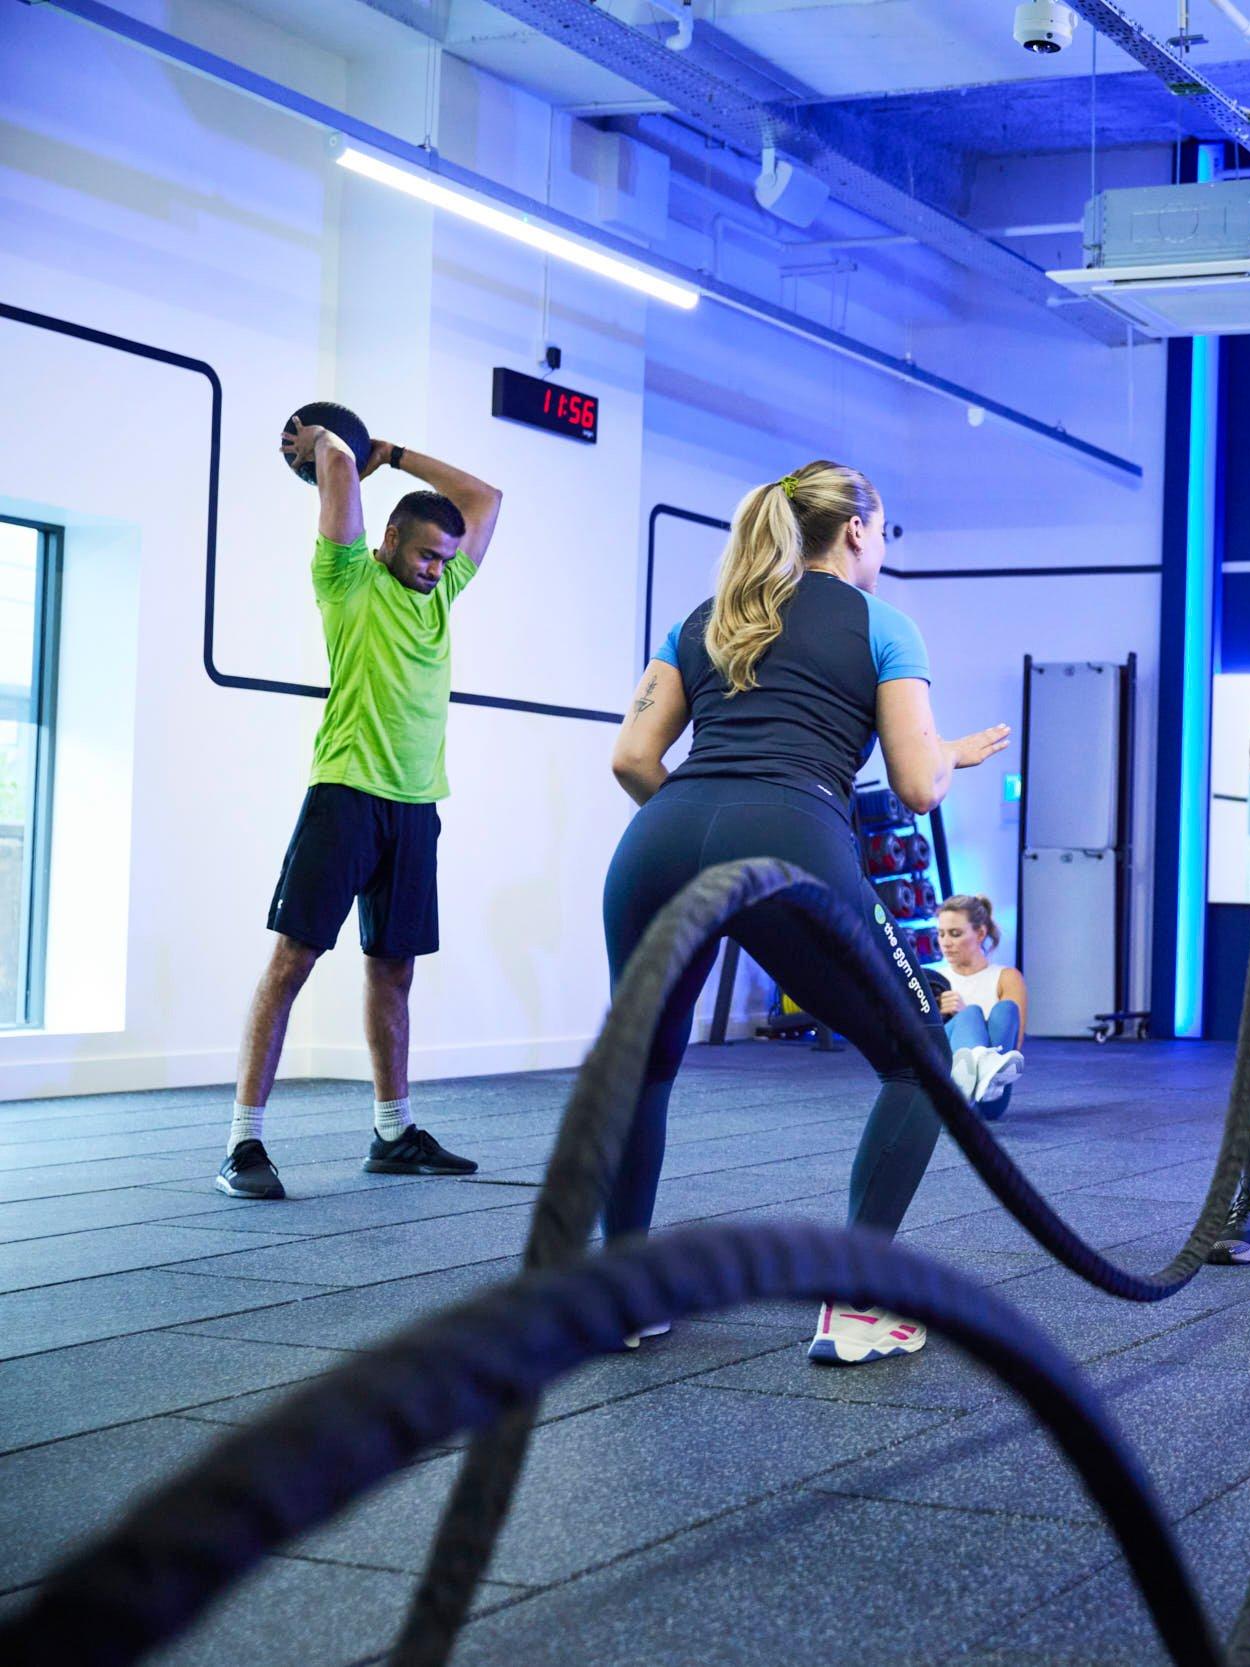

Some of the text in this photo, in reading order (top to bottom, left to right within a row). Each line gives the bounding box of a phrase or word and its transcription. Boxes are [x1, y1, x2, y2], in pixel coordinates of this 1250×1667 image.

[544, 388, 595, 428] 11:56
[884, 922, 931, 1014] the gym group
